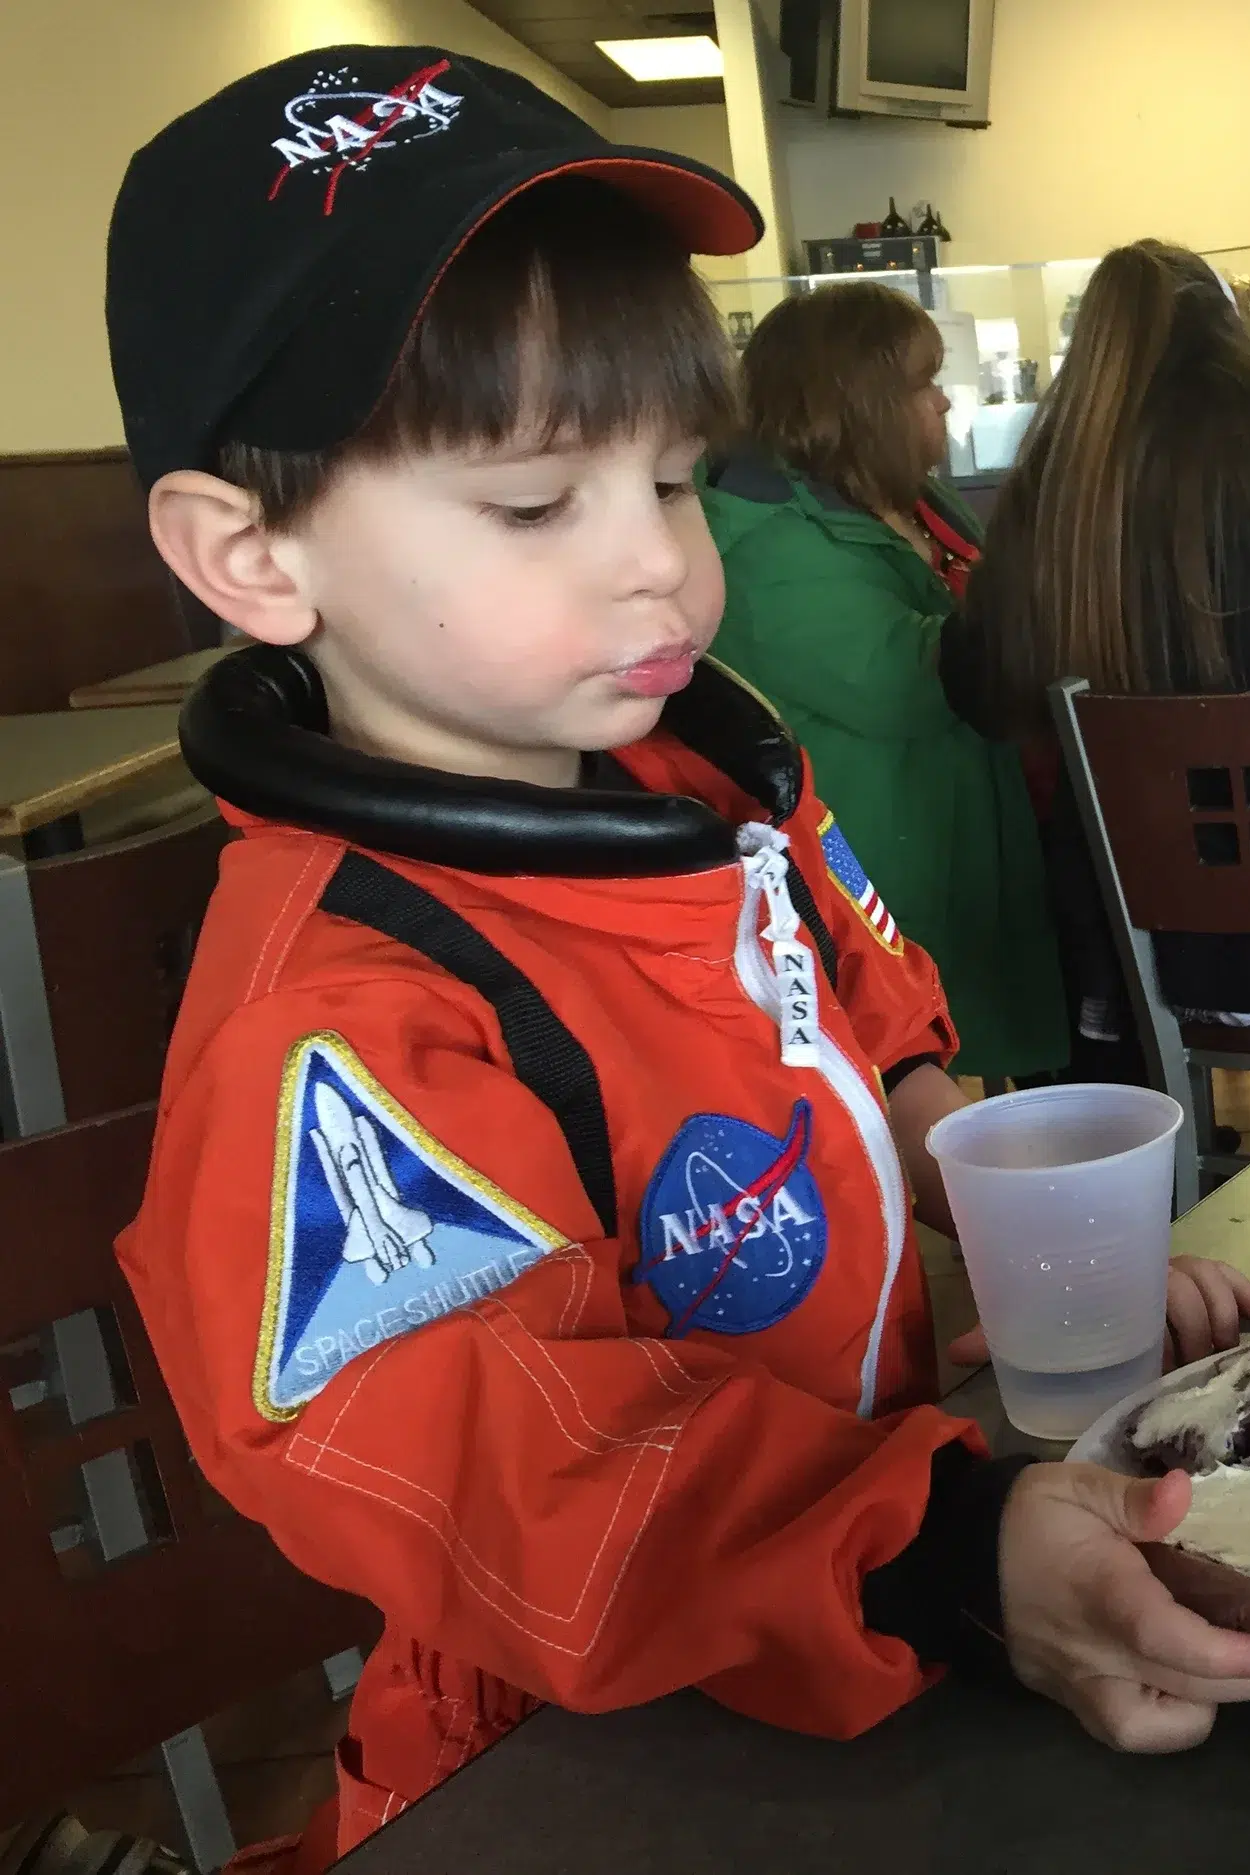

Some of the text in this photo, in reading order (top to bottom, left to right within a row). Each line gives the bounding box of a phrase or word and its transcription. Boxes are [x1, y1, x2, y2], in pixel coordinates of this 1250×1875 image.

[271, 83, 465, 168] NASA
[782, 953, 812, 1045] NASA
[658, 1185, 817, 1262] NASA
